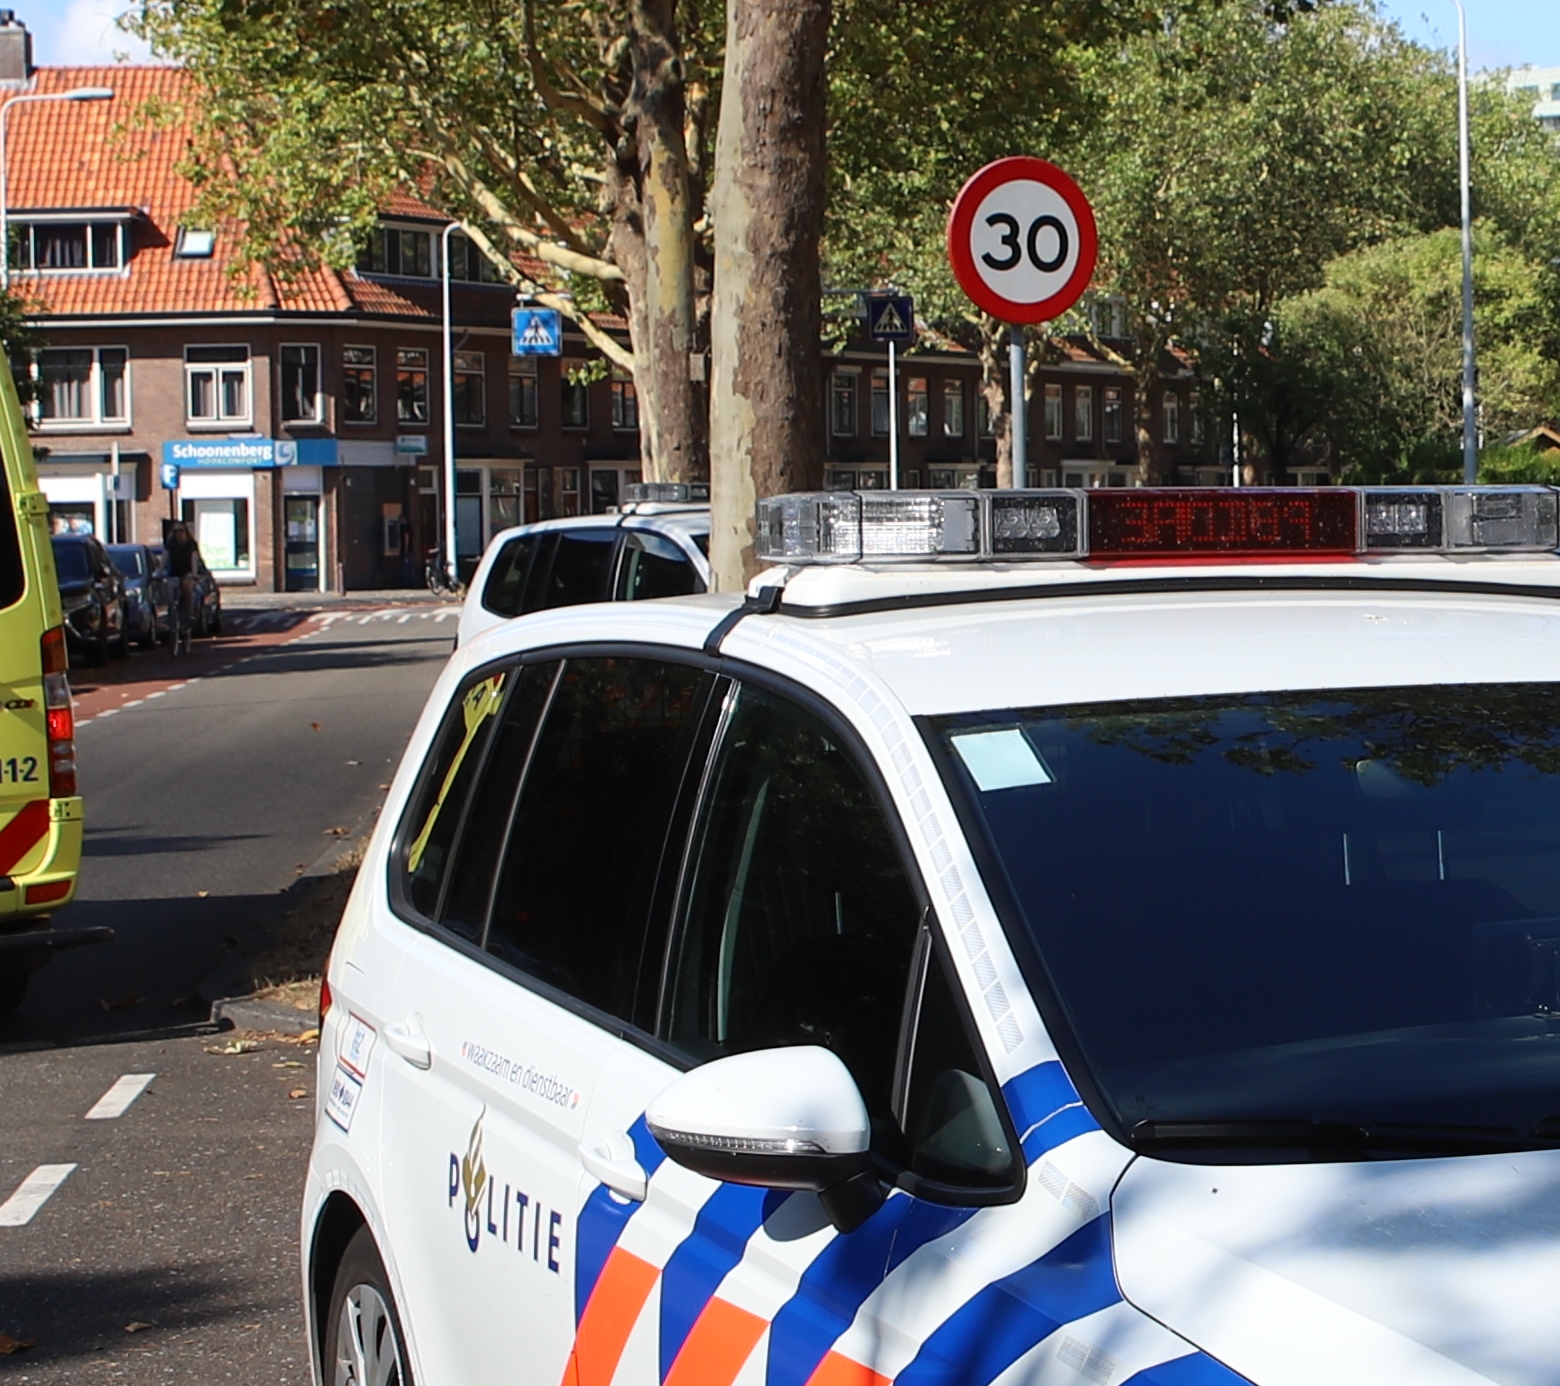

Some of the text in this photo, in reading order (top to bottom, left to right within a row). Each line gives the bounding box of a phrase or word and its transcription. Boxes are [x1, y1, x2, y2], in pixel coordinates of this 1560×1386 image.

[981, 212, 1069, 273] 30
[172, 442, 273, 461] Schoonenberg
[447, 1151, 562, 1274] POLITIE
